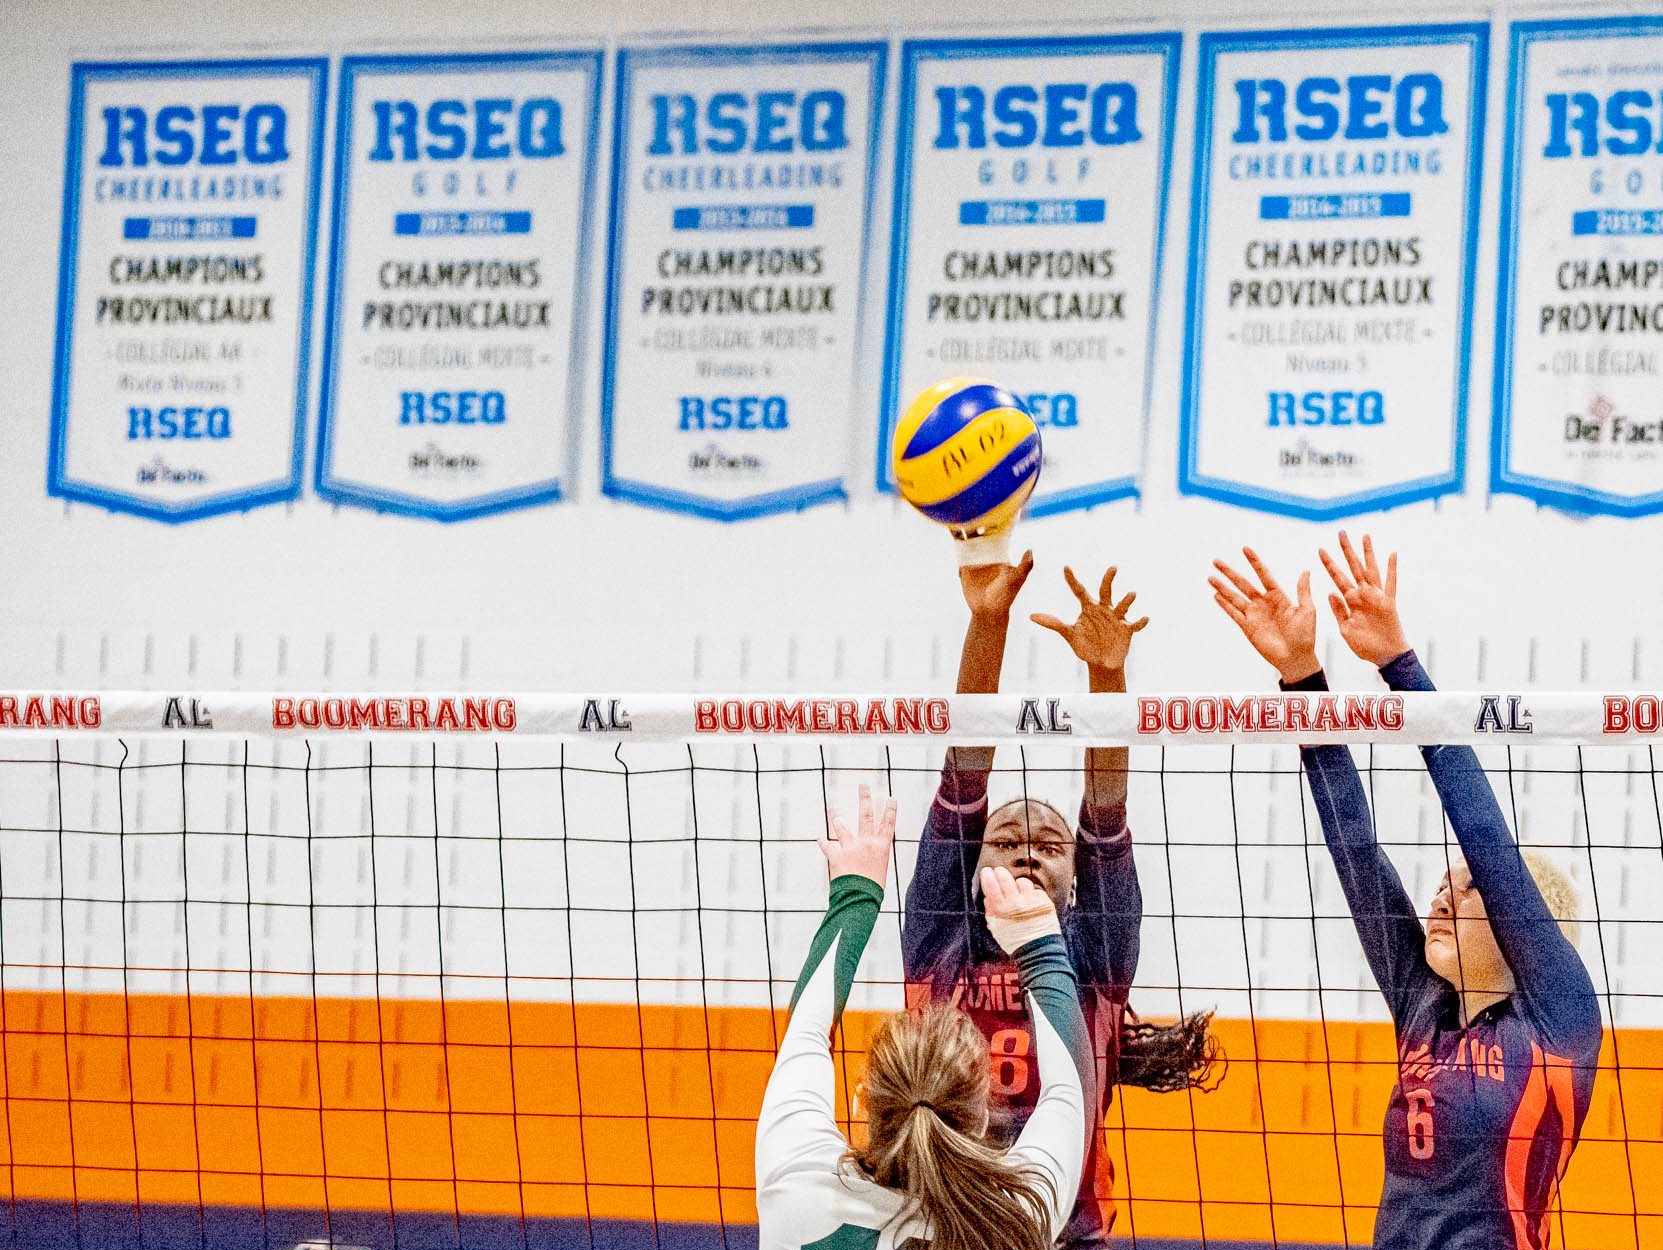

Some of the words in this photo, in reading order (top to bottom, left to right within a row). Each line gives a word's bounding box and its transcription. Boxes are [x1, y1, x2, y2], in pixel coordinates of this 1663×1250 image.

[646, 90, 850, 154] RSEQ
[934, 82, 1143, 149] RSEQ
[1232, 73, 1449, 143] RSEQ
[1543, 90, 1663, 158] RS
[98, 103, 289, 166] RSEQ
[368, 98, 565, 161] RSEQ
[643, 163, 844, 191] CHEERLEADING
[979, 157, 1091, 186] GOLF
[1229, 148, 1442, 180] CHEERLEADING
[95, 174, 282, 202] CHEERLEADING
[412, 167, 517, 197] GOLF
[1590, 169, 1663, 195] GO
[109, 254, 264, 286] CHAMPIONS
[657, 246, 824, 280] CHAMPIONS
[944, 249, 1116, 282] CHAMPIONS
[1245, 236, 1422, 271] CHAMPIONS
[380, 258, 542, 290] CHAMPIONS
[1557, 259, 1663, 290] CHAMP
[641, 284, 836, 316] PROVINCIAUX
[928, 293, 1126, 323] PROVINCIAUX
[1228, 276, 1434, 309] PROVINCIAUX
[96, 297, 274, 326] PROVINCIAUX
[363, 300, 552, 331] PROVINCIAUX
[128, 406, 232, 441] RSEQ
[399, 390, 507, 426] RSEQ
[678, 396, 790, 432] RSEQ
[1268, 390, 1385, 427] RSEQ
[273, 697, 517, 732] BOOMERANG
[578, 697, 632, 732] AL
[694, 697, 951, 734] BOOMERANG
[1016, 697, 1072, 734] AL
[1137, 695, 1405, 734] BOOMERANG
[1474, 695, 1533, 734] AL
[1602, 695, 1663, 734] BO
[990, 1028, 1031, 1095] 8
[1406, 1088, 1435, 1160] 6
